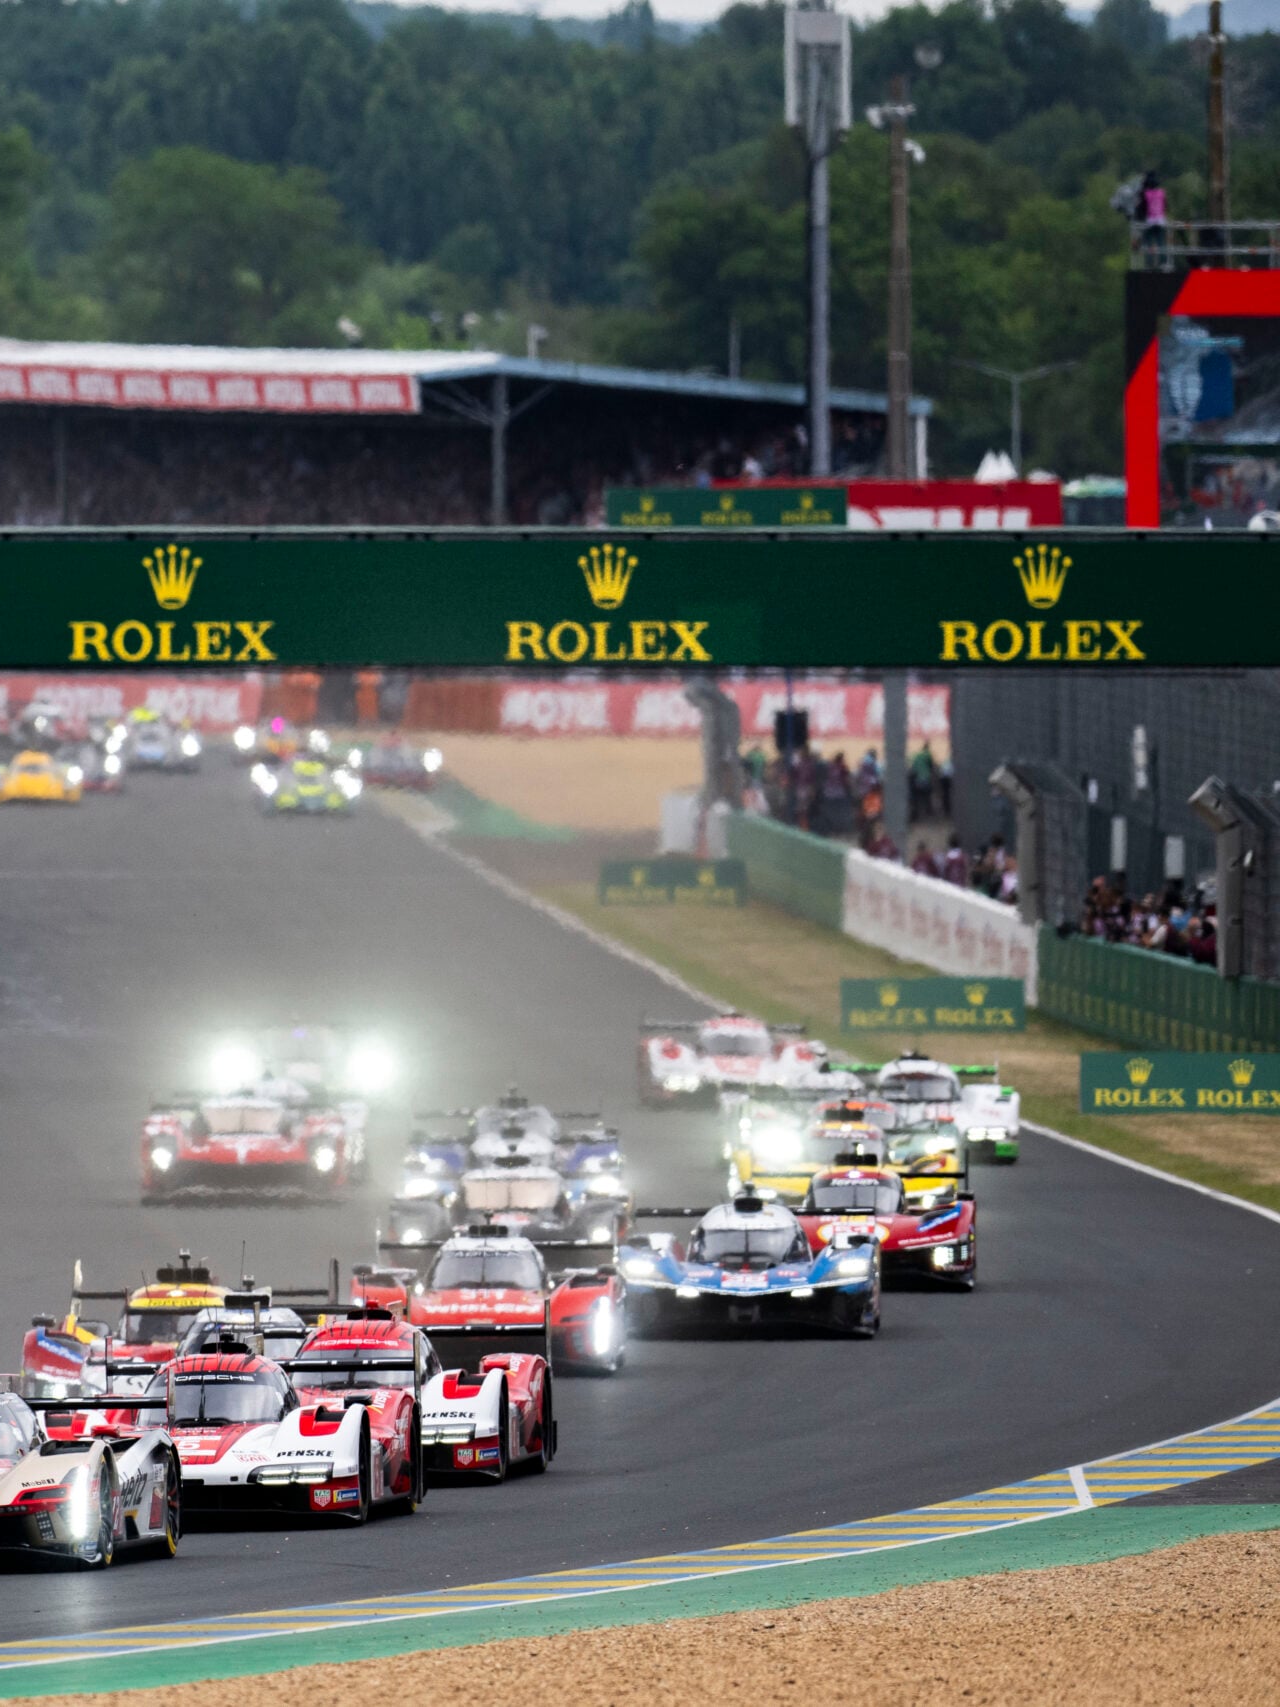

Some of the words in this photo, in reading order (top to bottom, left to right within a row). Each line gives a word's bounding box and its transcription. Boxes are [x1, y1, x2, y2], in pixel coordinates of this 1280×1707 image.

[68, 620, 277, 663] ROLEX
[505, 620, 712, 663] ROLEX
[939, 619, 1146, 662] ROLEX
[1093, 1088, 1186, 1107] ROLEX
[165, 1372, 256, 1383] ORSCHE
[277, 1449, 335, 1458] PENSKE
